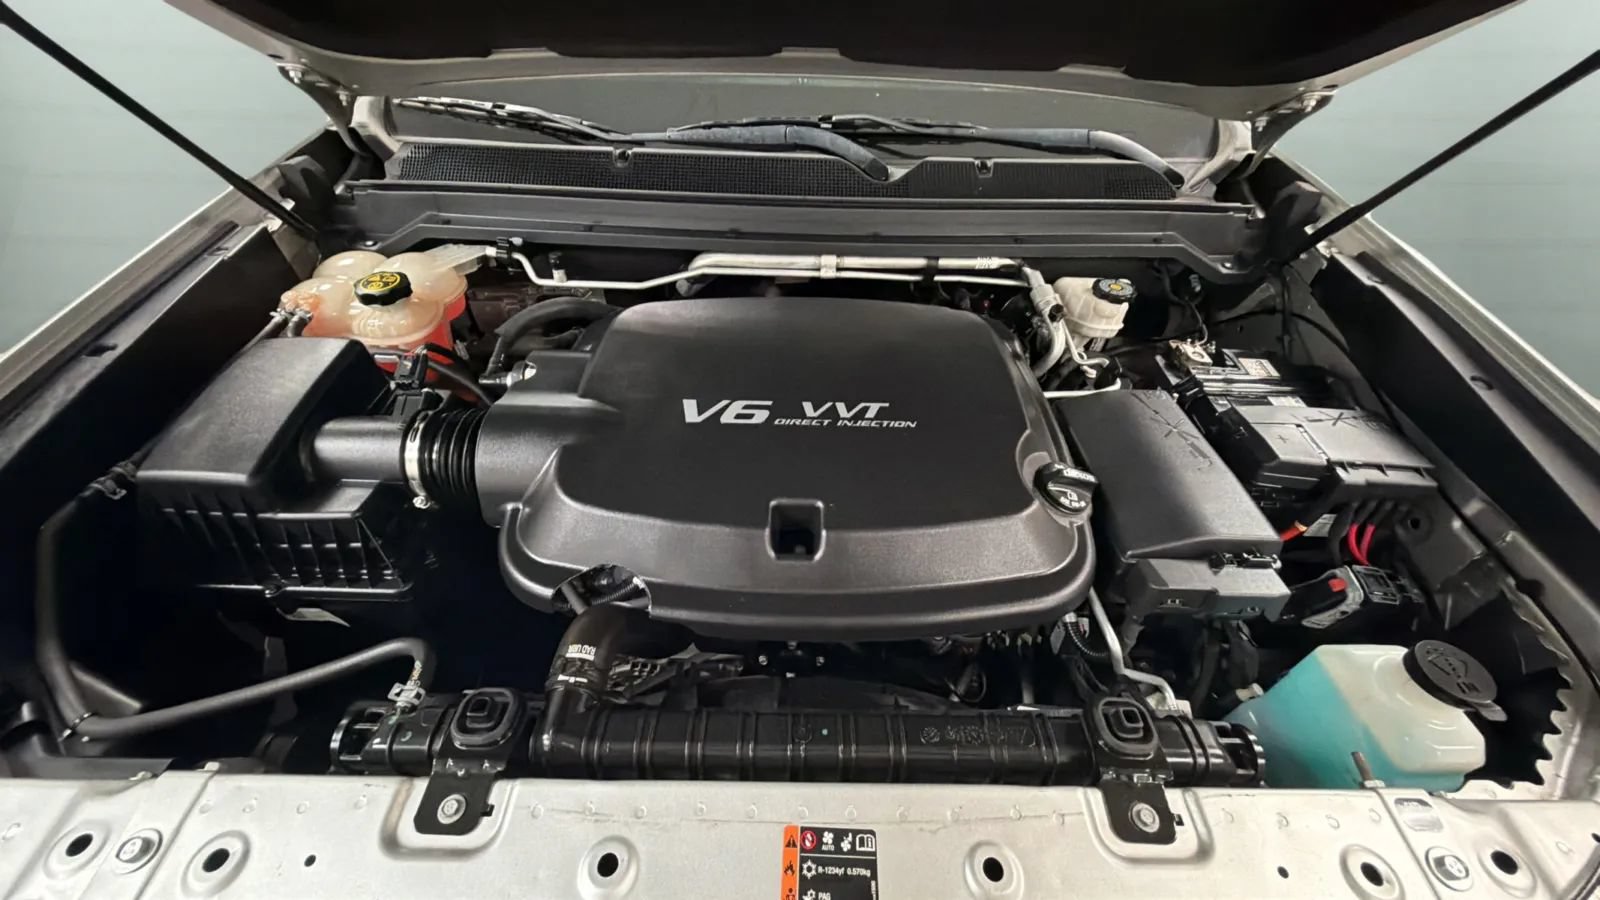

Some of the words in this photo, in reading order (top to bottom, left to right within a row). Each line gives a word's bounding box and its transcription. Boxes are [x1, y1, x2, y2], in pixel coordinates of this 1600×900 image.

[682, 398, 774, 424] V6
[801, 401, 890, 419] VVT
[774, 418, 832, 427] DIRECT
[836, 420, 917, 428] INJECTION
[818, 866, 844, 876] R-1234yf
[847, 868, 870, 877] 0.570kg
